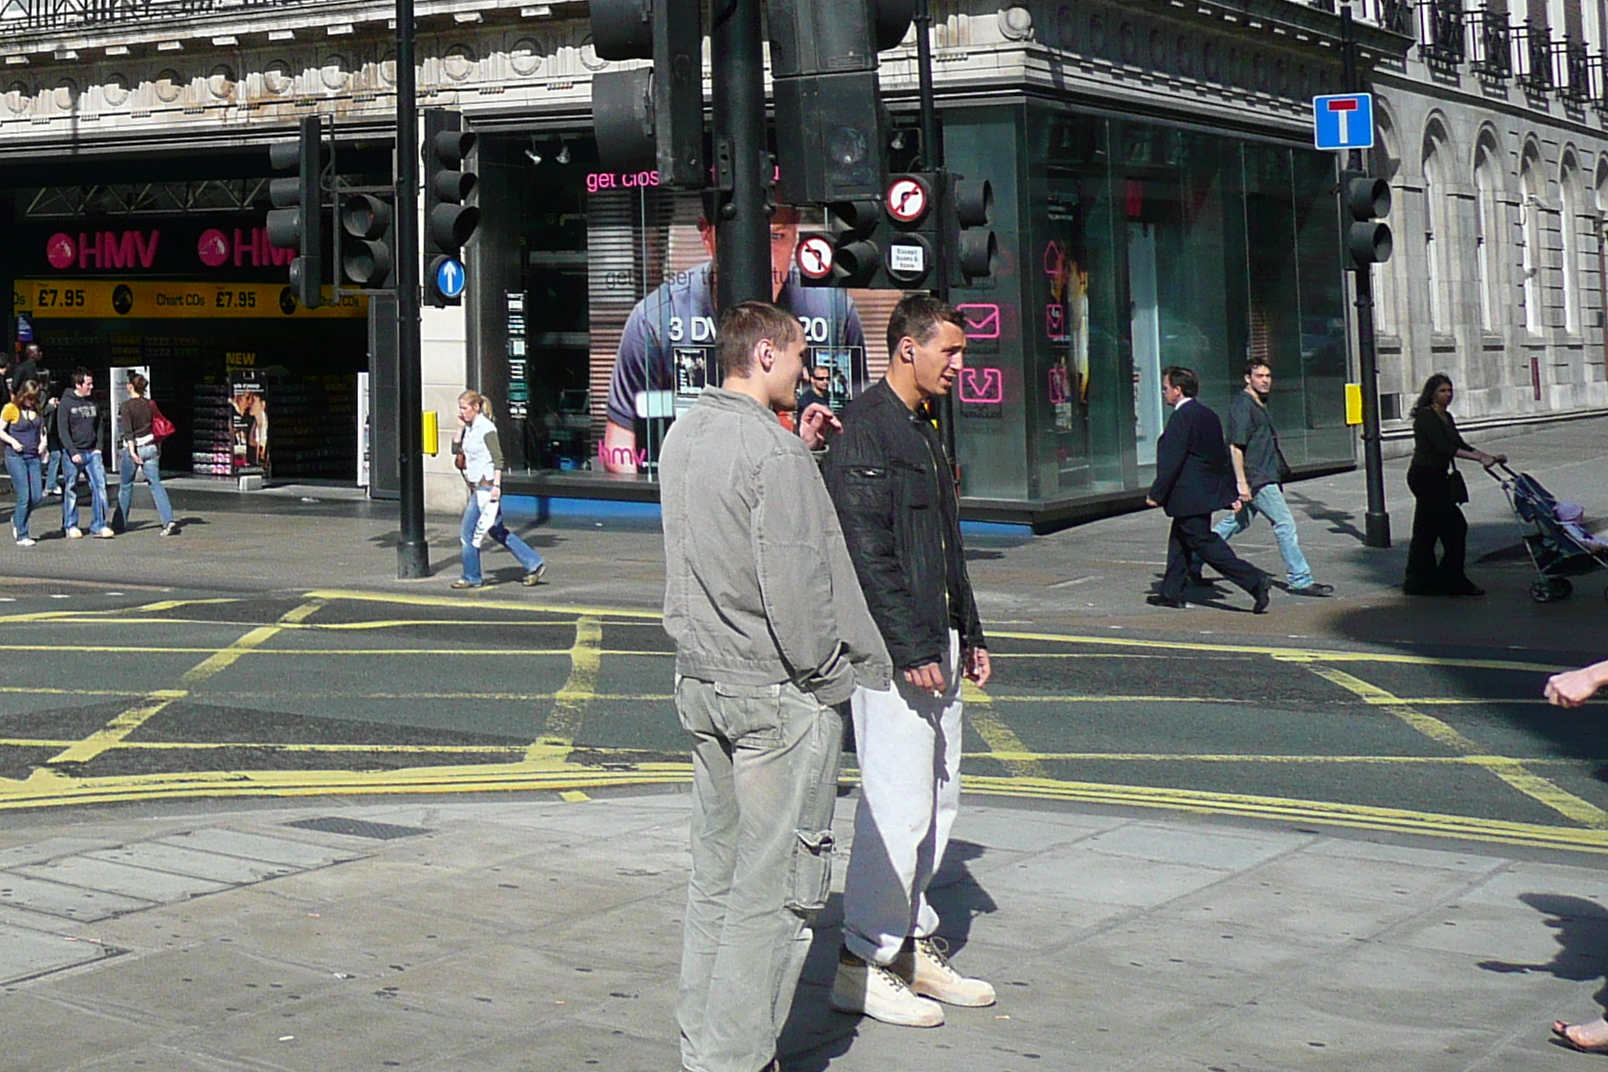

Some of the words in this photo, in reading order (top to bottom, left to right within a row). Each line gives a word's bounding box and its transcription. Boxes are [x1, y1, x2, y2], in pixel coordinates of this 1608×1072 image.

[621, 170, 660, 187] clos
[79, 230, 160, 269] HMV
[233, 227, 298, 267] HM
[38, 289, 85, 307] £7.95
[156, 293, 184, 307] Chart
[185, 294, 205, 306] CDs
[215, 291, 256, 308] £7.95
[668, 316, 684, 342] 3
[691, 316, 716, 342] DV
[226, 351, 256, 366] NEW
[598, 439, 646, 466] hmv
